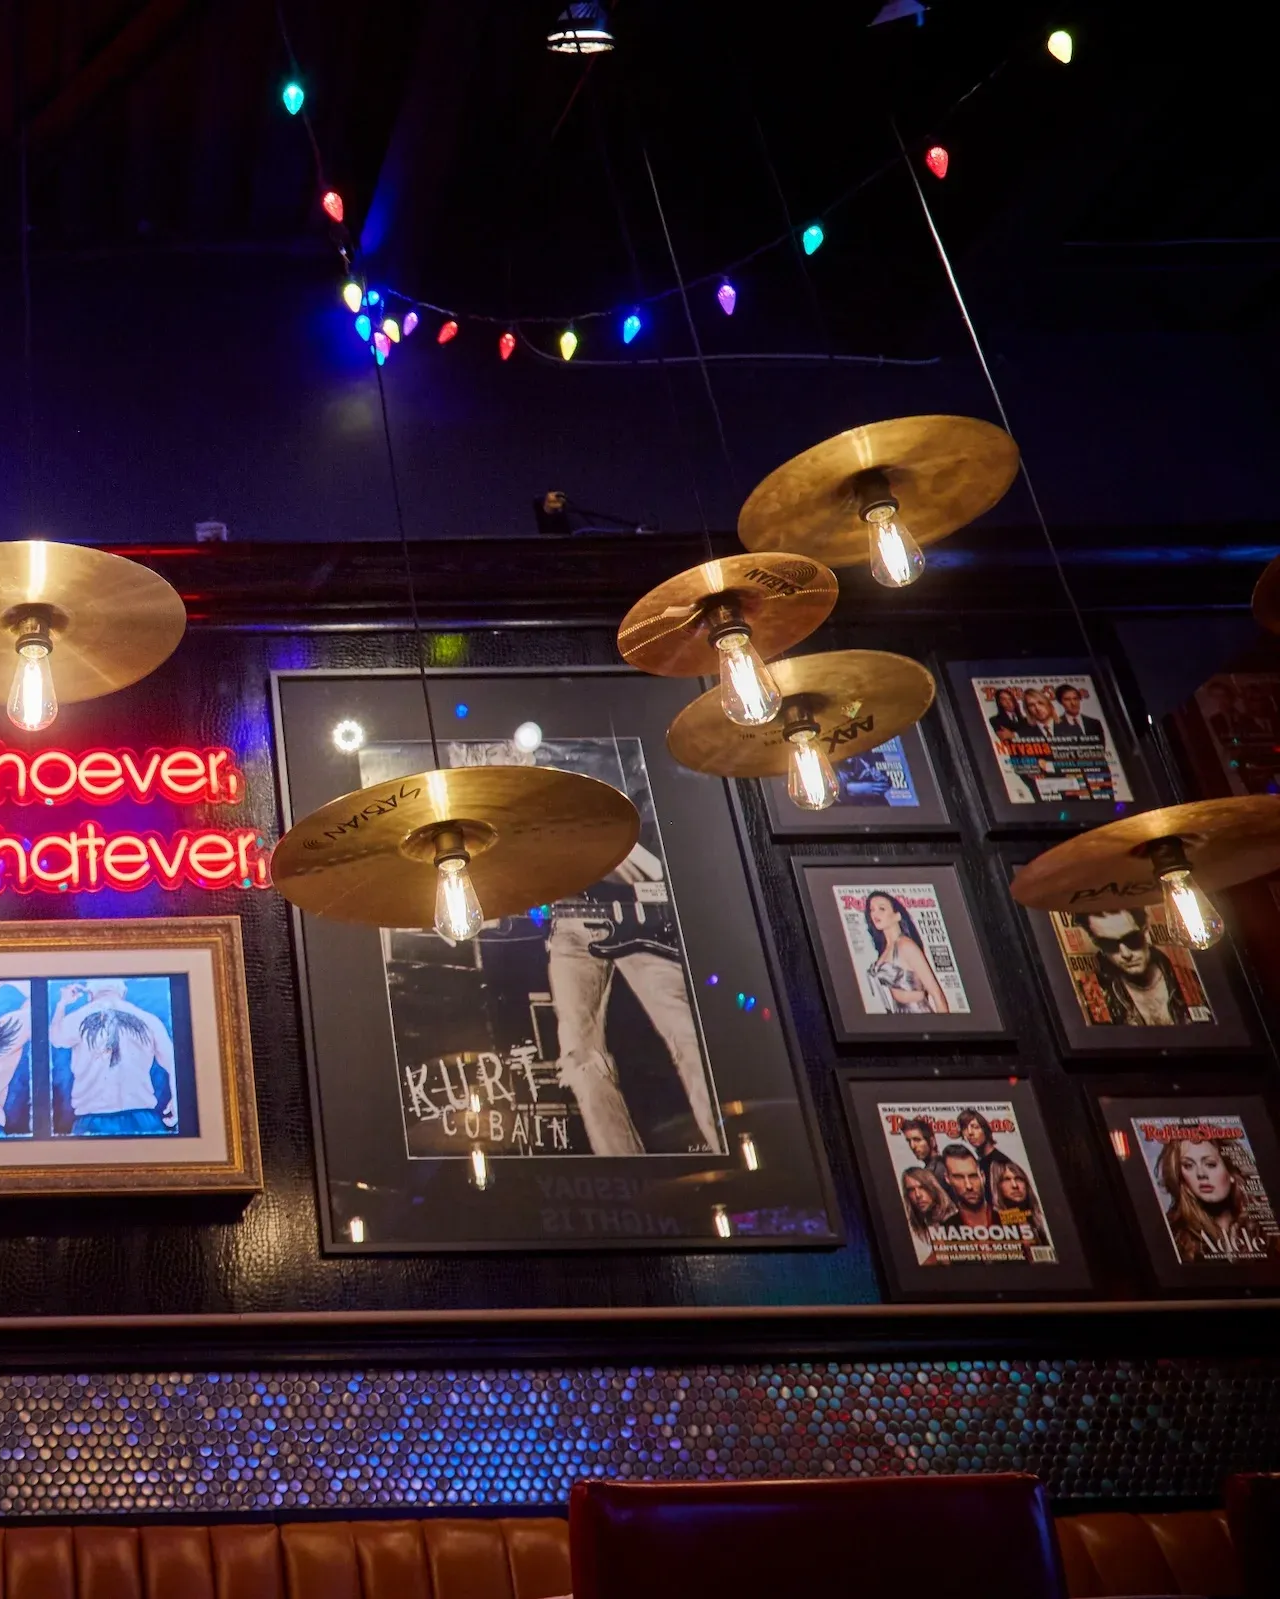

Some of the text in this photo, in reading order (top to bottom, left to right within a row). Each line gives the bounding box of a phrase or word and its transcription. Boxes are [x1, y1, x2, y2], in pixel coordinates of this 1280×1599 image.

[744, 568, 803, 595] SABIAN
[822, 715, 874, 753] AAX
[994, 740, 1052, 756] Nirvana
[323, 784, 422, 840] SABIAN
[404, 1039, 540, 1121] KURT
[442, 1104, 570, 1150] COBAIN
[928, 1224, 1035, 1241] MAROON 5
